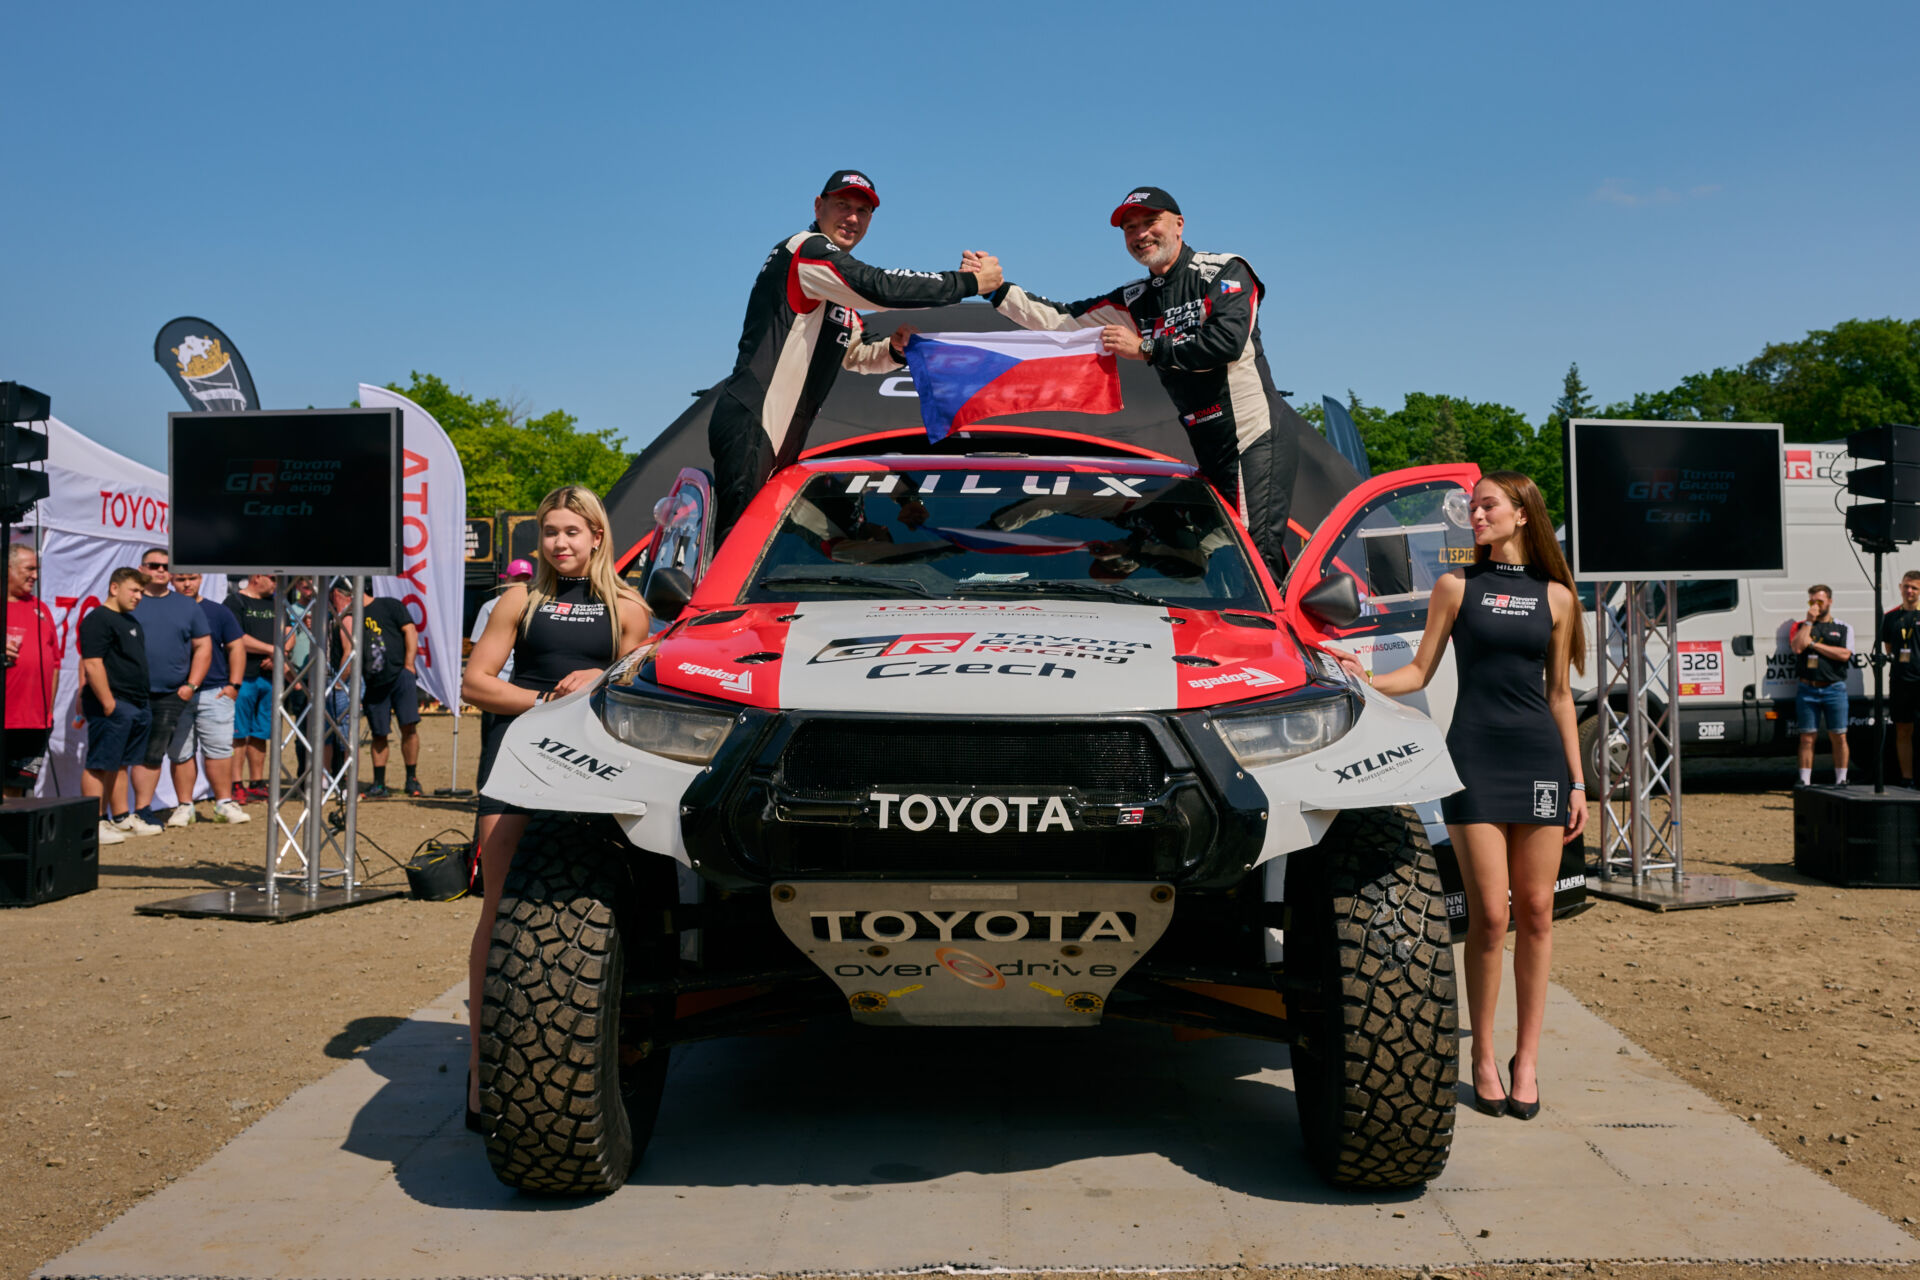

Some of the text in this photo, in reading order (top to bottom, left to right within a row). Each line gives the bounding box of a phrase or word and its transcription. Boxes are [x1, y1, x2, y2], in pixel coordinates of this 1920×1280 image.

[281, 460, 342, 470] TOYOTA
[225, 473, 274, 491] GR
[280, 471, 334, 481] GAZOO
[1681, 470, 1735, 480] TOYOTA
[845, 474, 1146, 497] HILUX
[1627, 481, 1674, 499] GR
[1679, 480, 1729, 490] GAZOO
[100, 490, 168, 534] TOYOT
[243, 500, 312, 516] Czech
[1644, 508, 1711, 523] Czech
[980, 638, 1135, 655] GAZOO
[988, 632, 1152, 649] TOYOTA
[811, 639, 966, 663] GR
[973, 645, 1129, 664] Racing
[1681, 653, 1718, 670] 328
[678, 662, 739, 681] agados
[866, 661, 1077, 680] Czech
[1187, 672, 1252, 689] agados
[1699, 725, 1725, 736] OMP
[870, 793, 1074, 834] TOYOTA
[1561, 874, 1585, 889] KAFKA
[810, 910, 1134, 942] TOYOTA
[834, 959, 1118, 977] over drive
